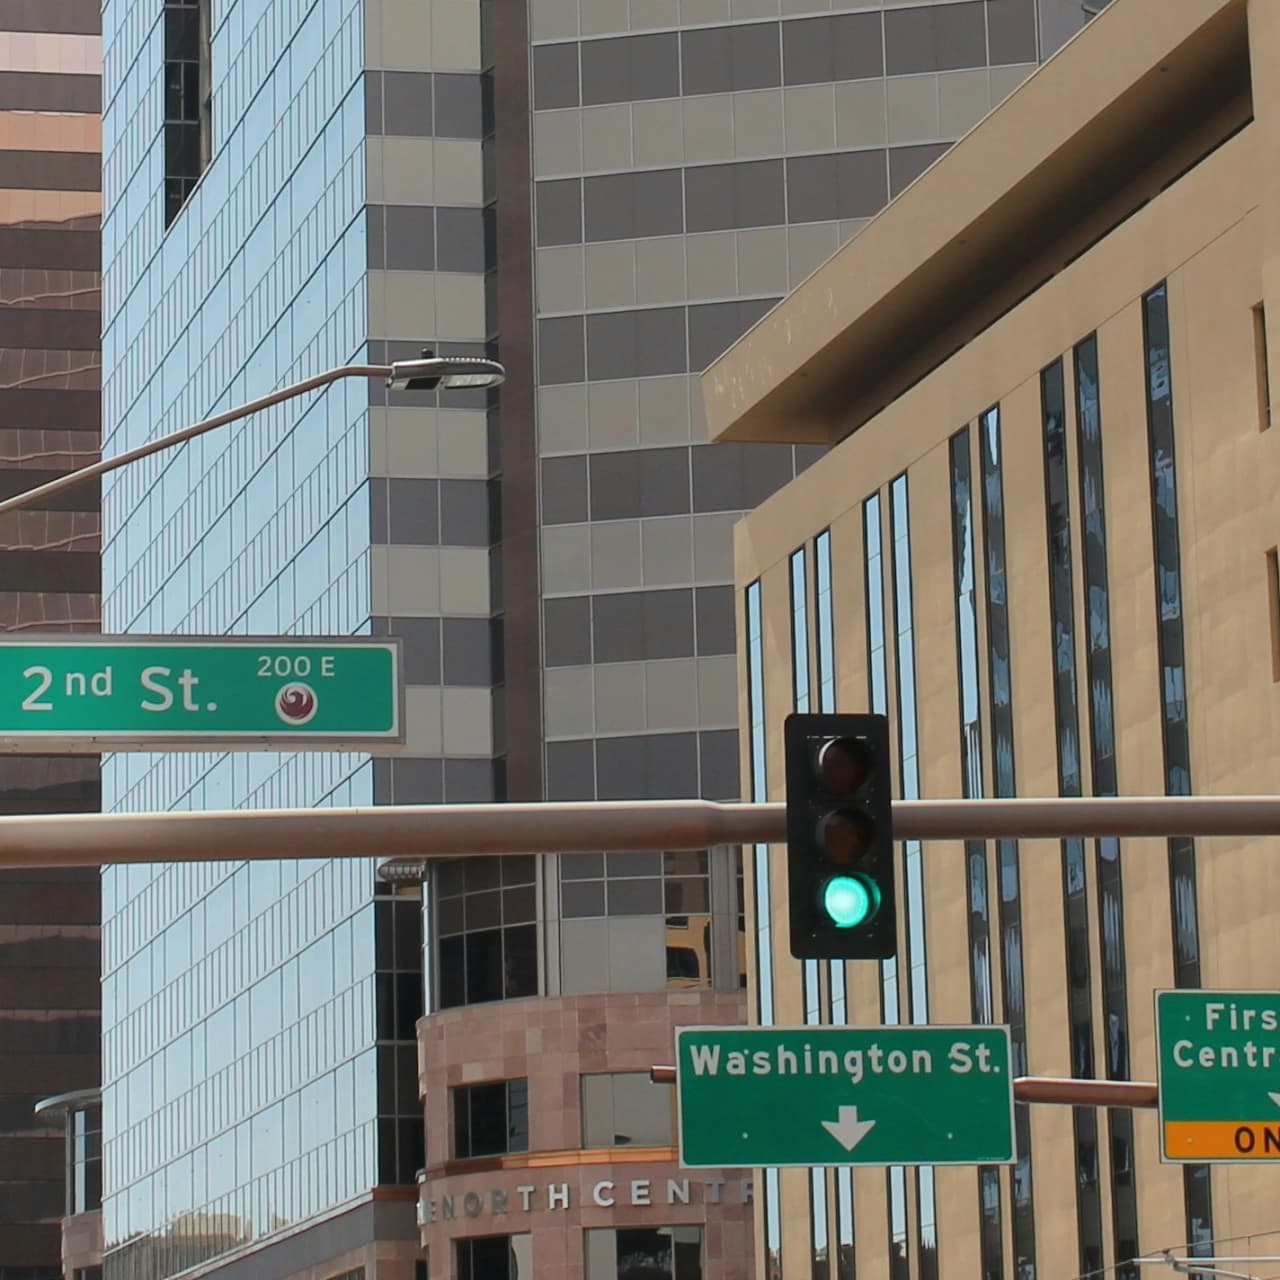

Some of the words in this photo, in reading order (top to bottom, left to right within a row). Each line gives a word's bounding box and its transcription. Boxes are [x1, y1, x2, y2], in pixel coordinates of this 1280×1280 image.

[257, 655, 311, 677] 200
[321, 656, 335, 676] E
[21, 666, 112, 711] 2nd
[140, 666, 218, 711] St.
[689, 1043, 933, 1085] Washington
[949, 1042, 1001, 1074] St.
[442, 1183, 570, 1220] NORTH
